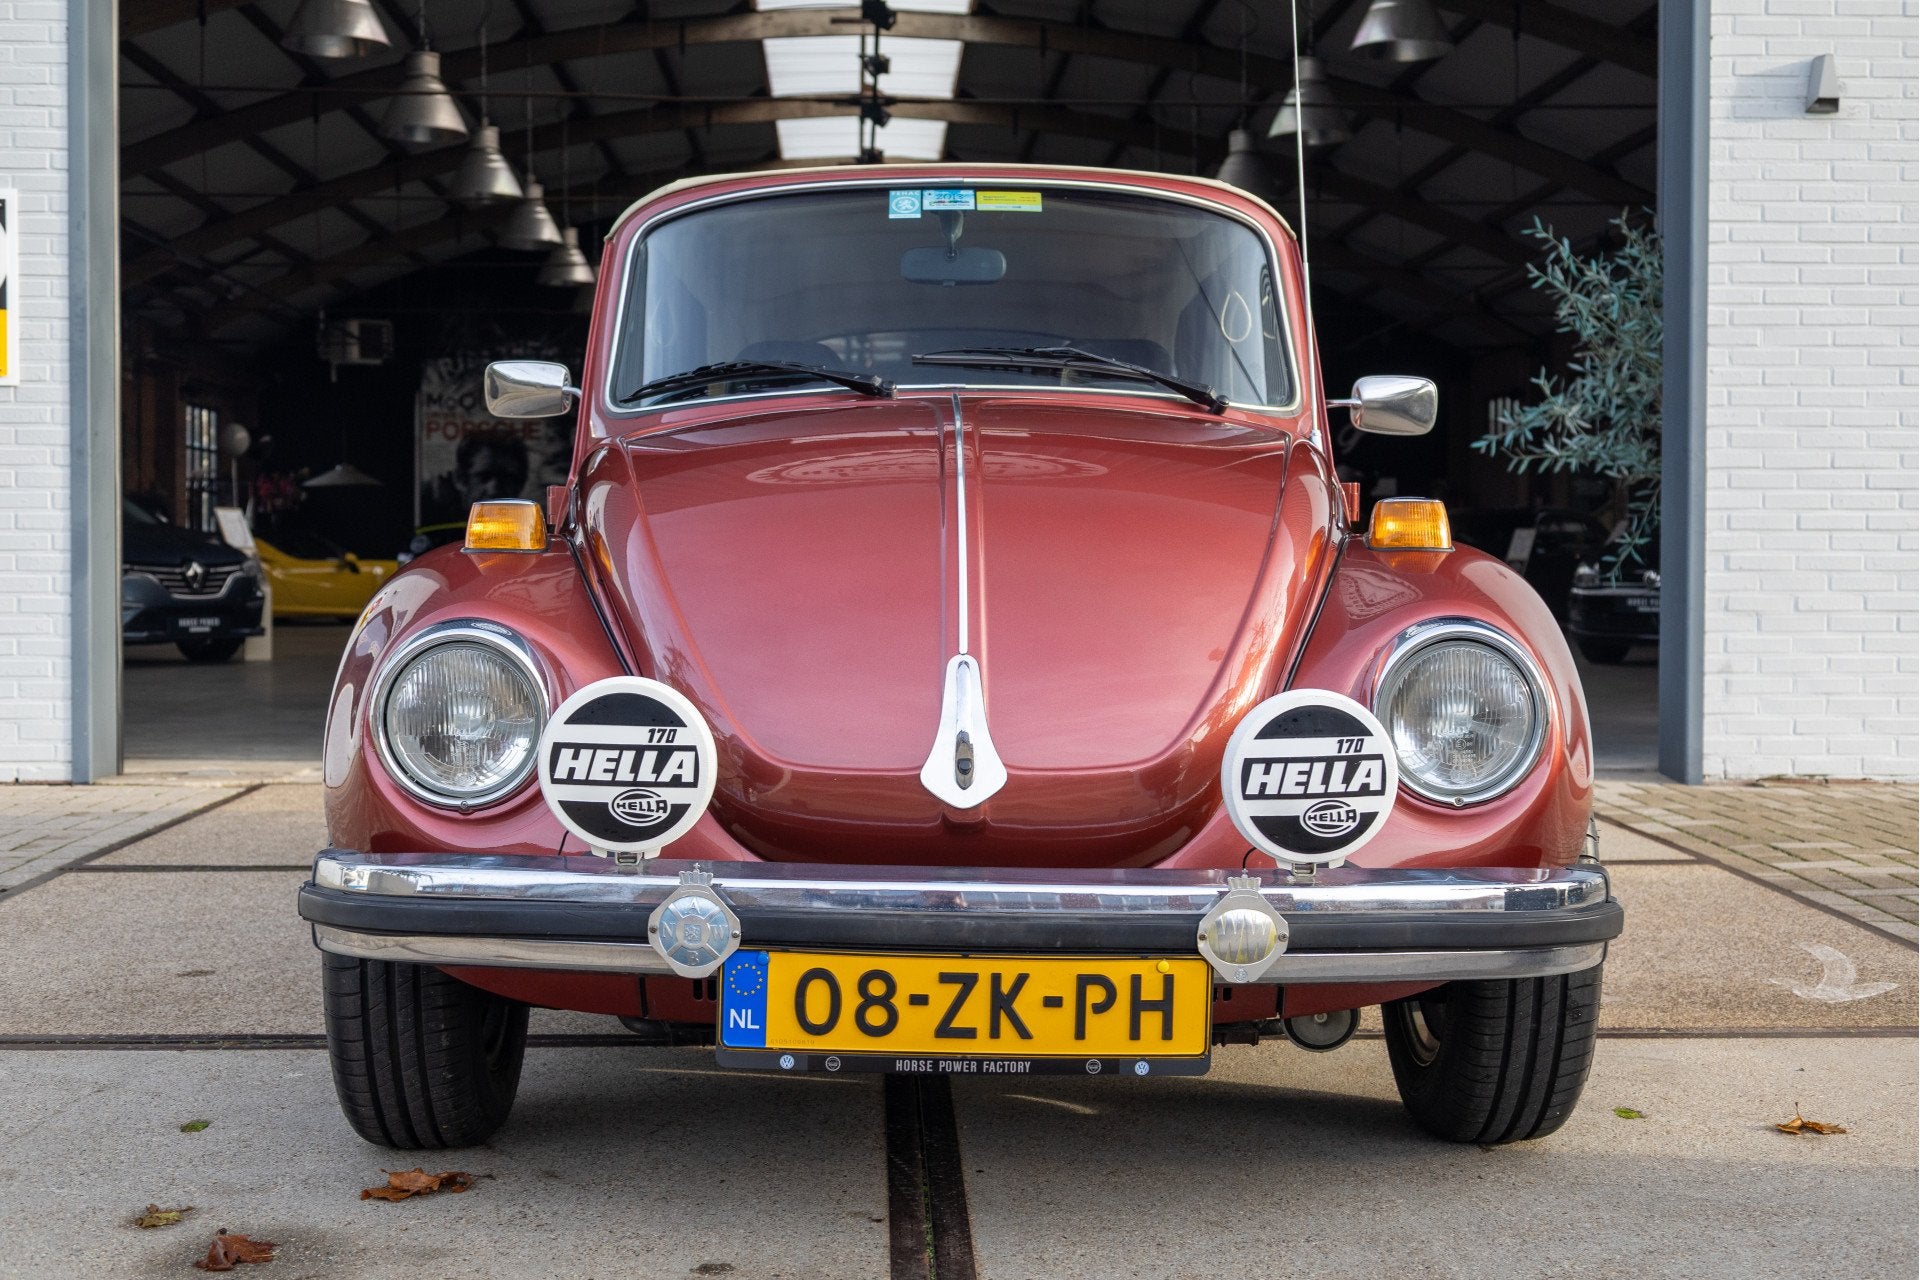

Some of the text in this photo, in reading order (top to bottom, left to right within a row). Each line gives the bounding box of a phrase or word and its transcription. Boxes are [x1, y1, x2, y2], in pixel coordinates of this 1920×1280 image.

[426, 420, 541, 441] PORSCHE
[648, 728, 677, 744] 170
[1337, 738, 1364, 754] 170
[553, 748, 696, 783] HELLA
[1245, 759, 1383, 795] HELLA
[616, 799, 668, 814] HELLA
[1307, 808, 1357, 823] HELLA
[795, 967, 1174, 1041] 08-ZK-PH
[730, 1008, 760, 1030] NL
[896, 1060, 1031, 1073] HORSE POWER FACTORY
